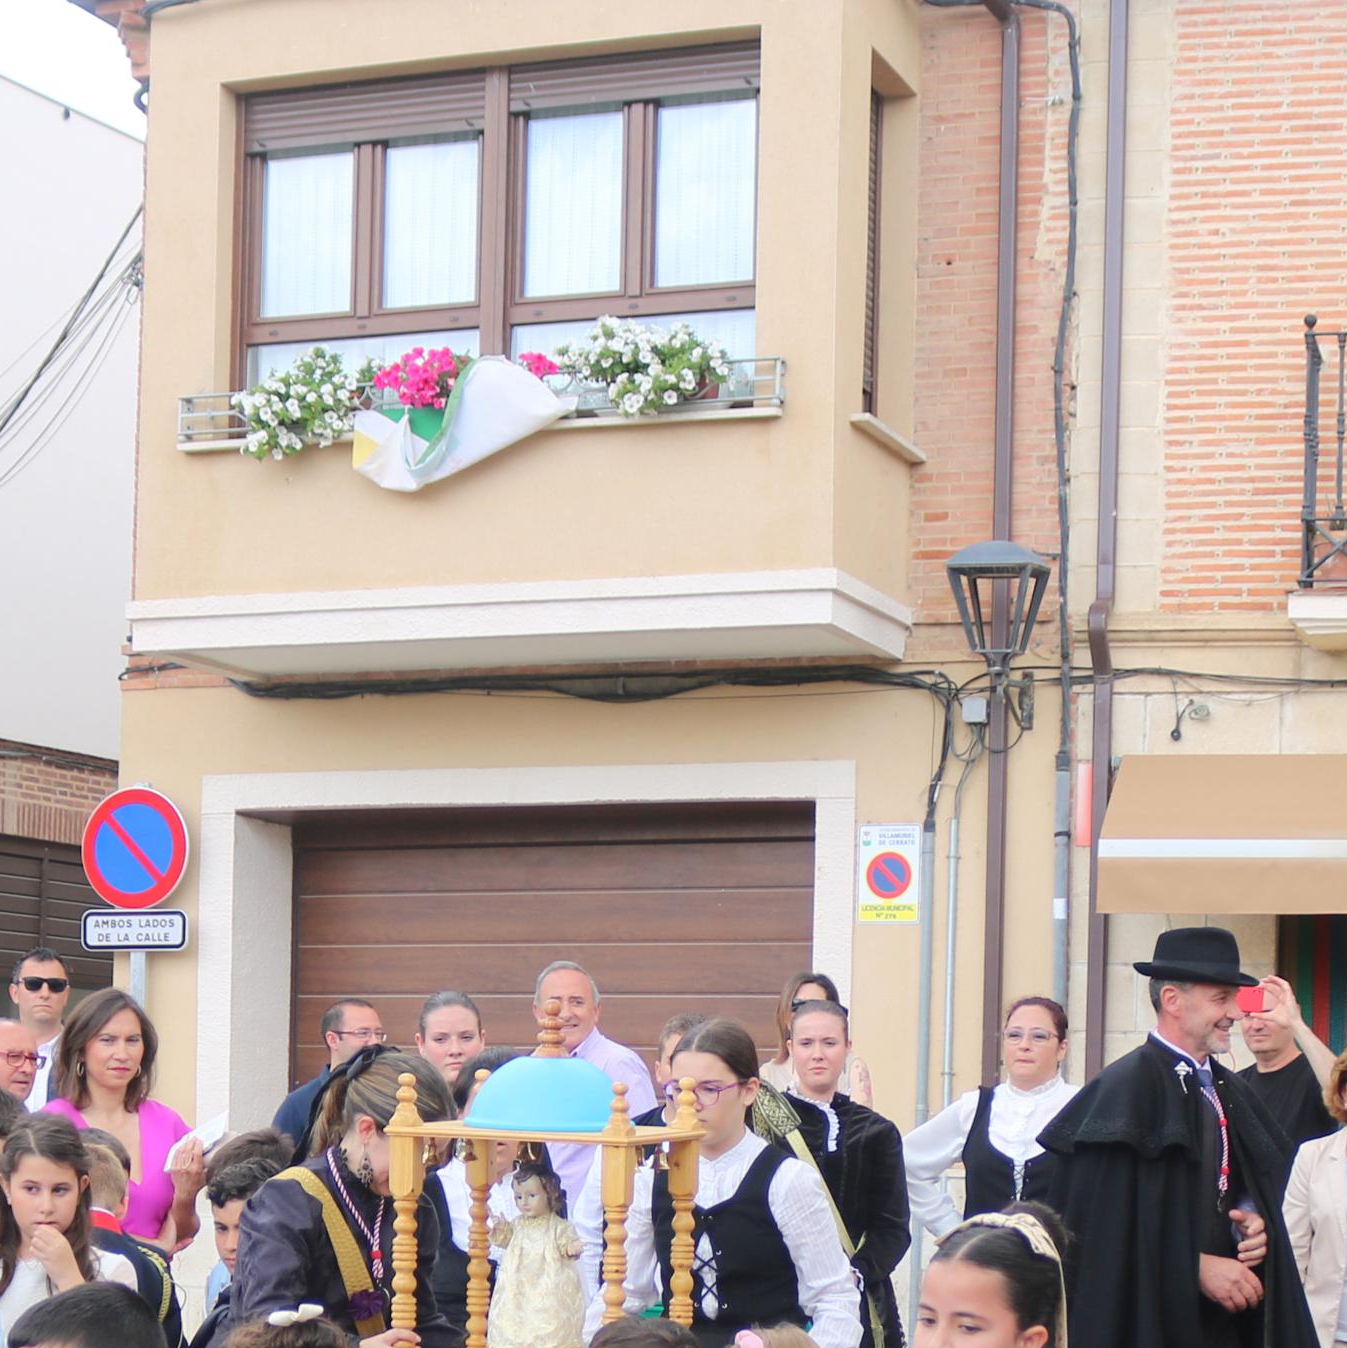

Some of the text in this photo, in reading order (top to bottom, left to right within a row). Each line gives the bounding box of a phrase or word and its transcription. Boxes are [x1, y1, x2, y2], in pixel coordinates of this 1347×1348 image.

[94, 918, 175, 929] AMBOS LADOS
[97, 933, 170, 942] DE LA CALLE
